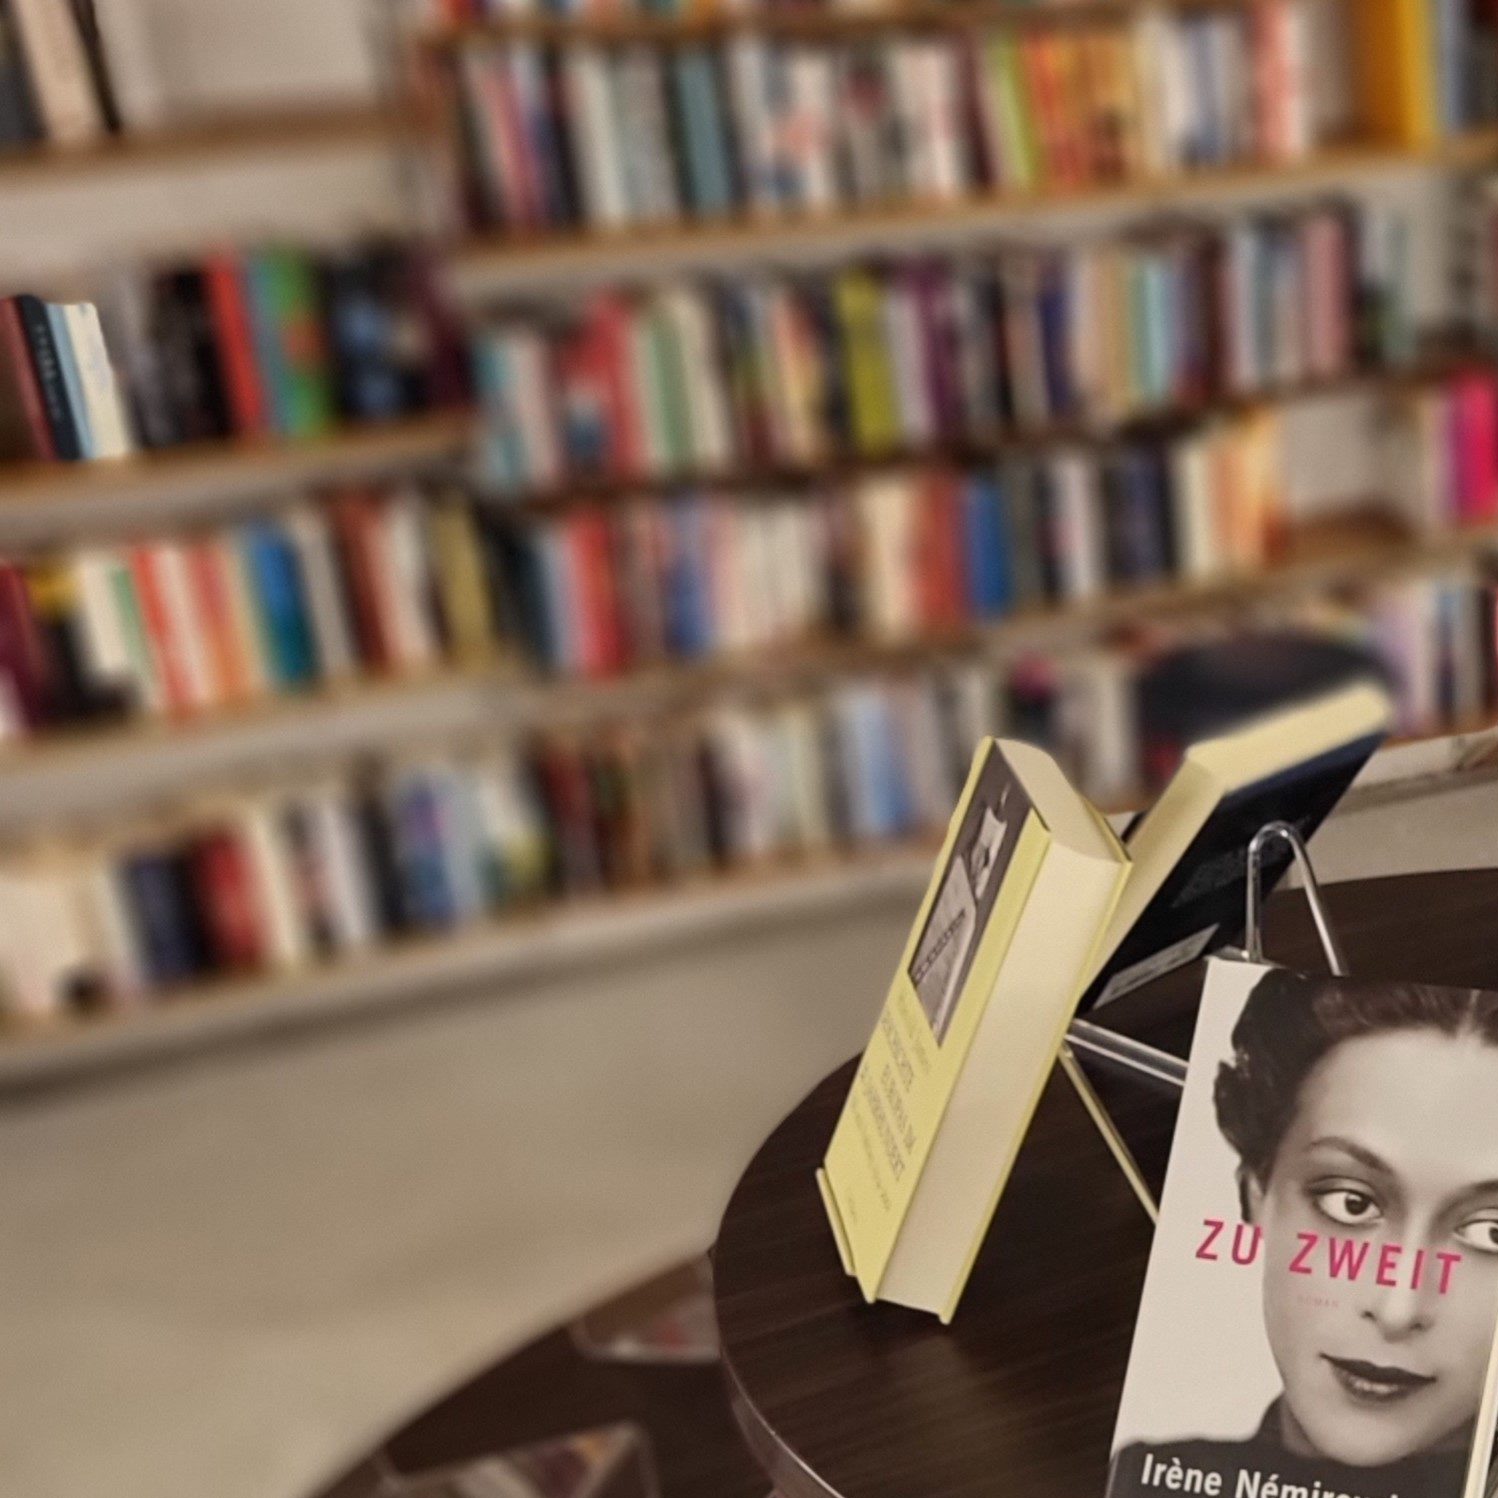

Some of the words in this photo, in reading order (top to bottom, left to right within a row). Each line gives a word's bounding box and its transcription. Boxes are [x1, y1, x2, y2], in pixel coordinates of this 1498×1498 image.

[1194, 1219, 1264, 1266] ZU
[1288, 1231, 1462, 1295] ZWEIT
[1140, 1453, 1223, 1497] Irène
